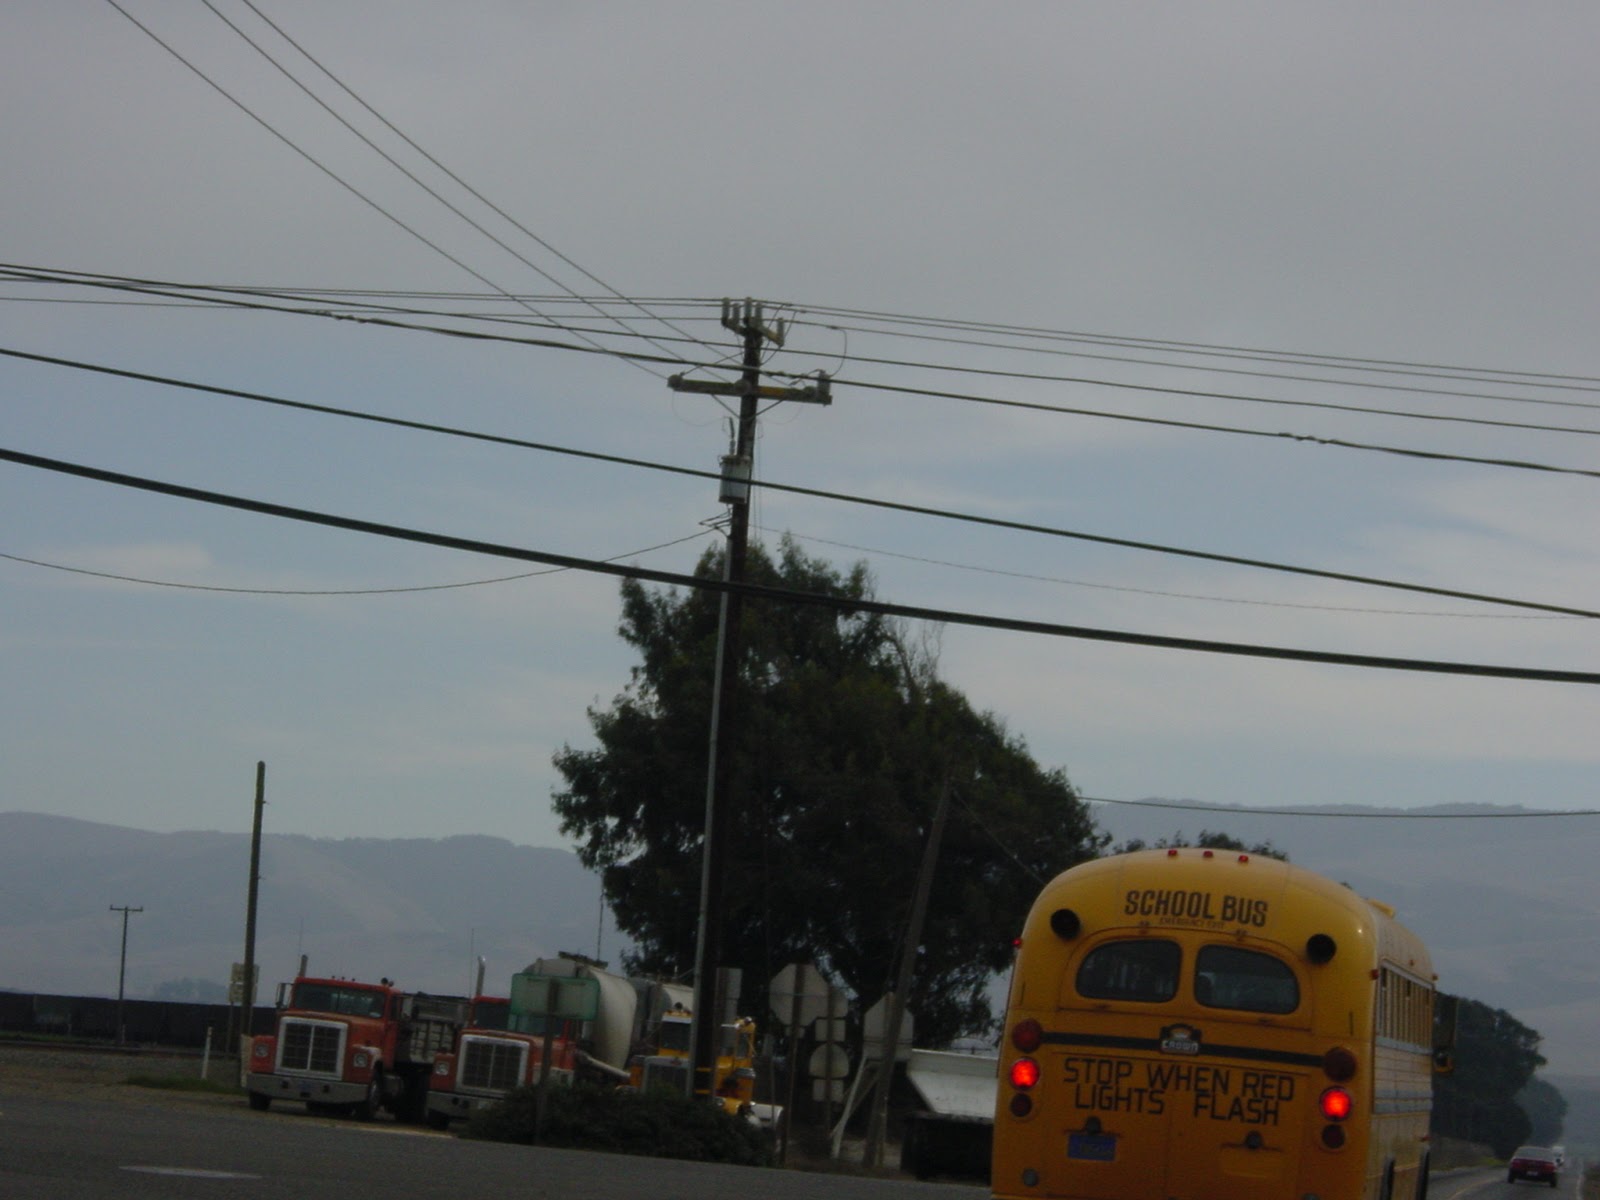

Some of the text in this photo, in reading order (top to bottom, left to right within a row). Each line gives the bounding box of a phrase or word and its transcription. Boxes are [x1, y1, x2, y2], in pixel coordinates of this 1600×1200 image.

[1125, 890, 1268, 927] SCHOOL BUS
[1063, 1058, 1294, 1101] STOP WHEN RED
[1075, 1086, 1279, 1125] LIGHTS FLASH
